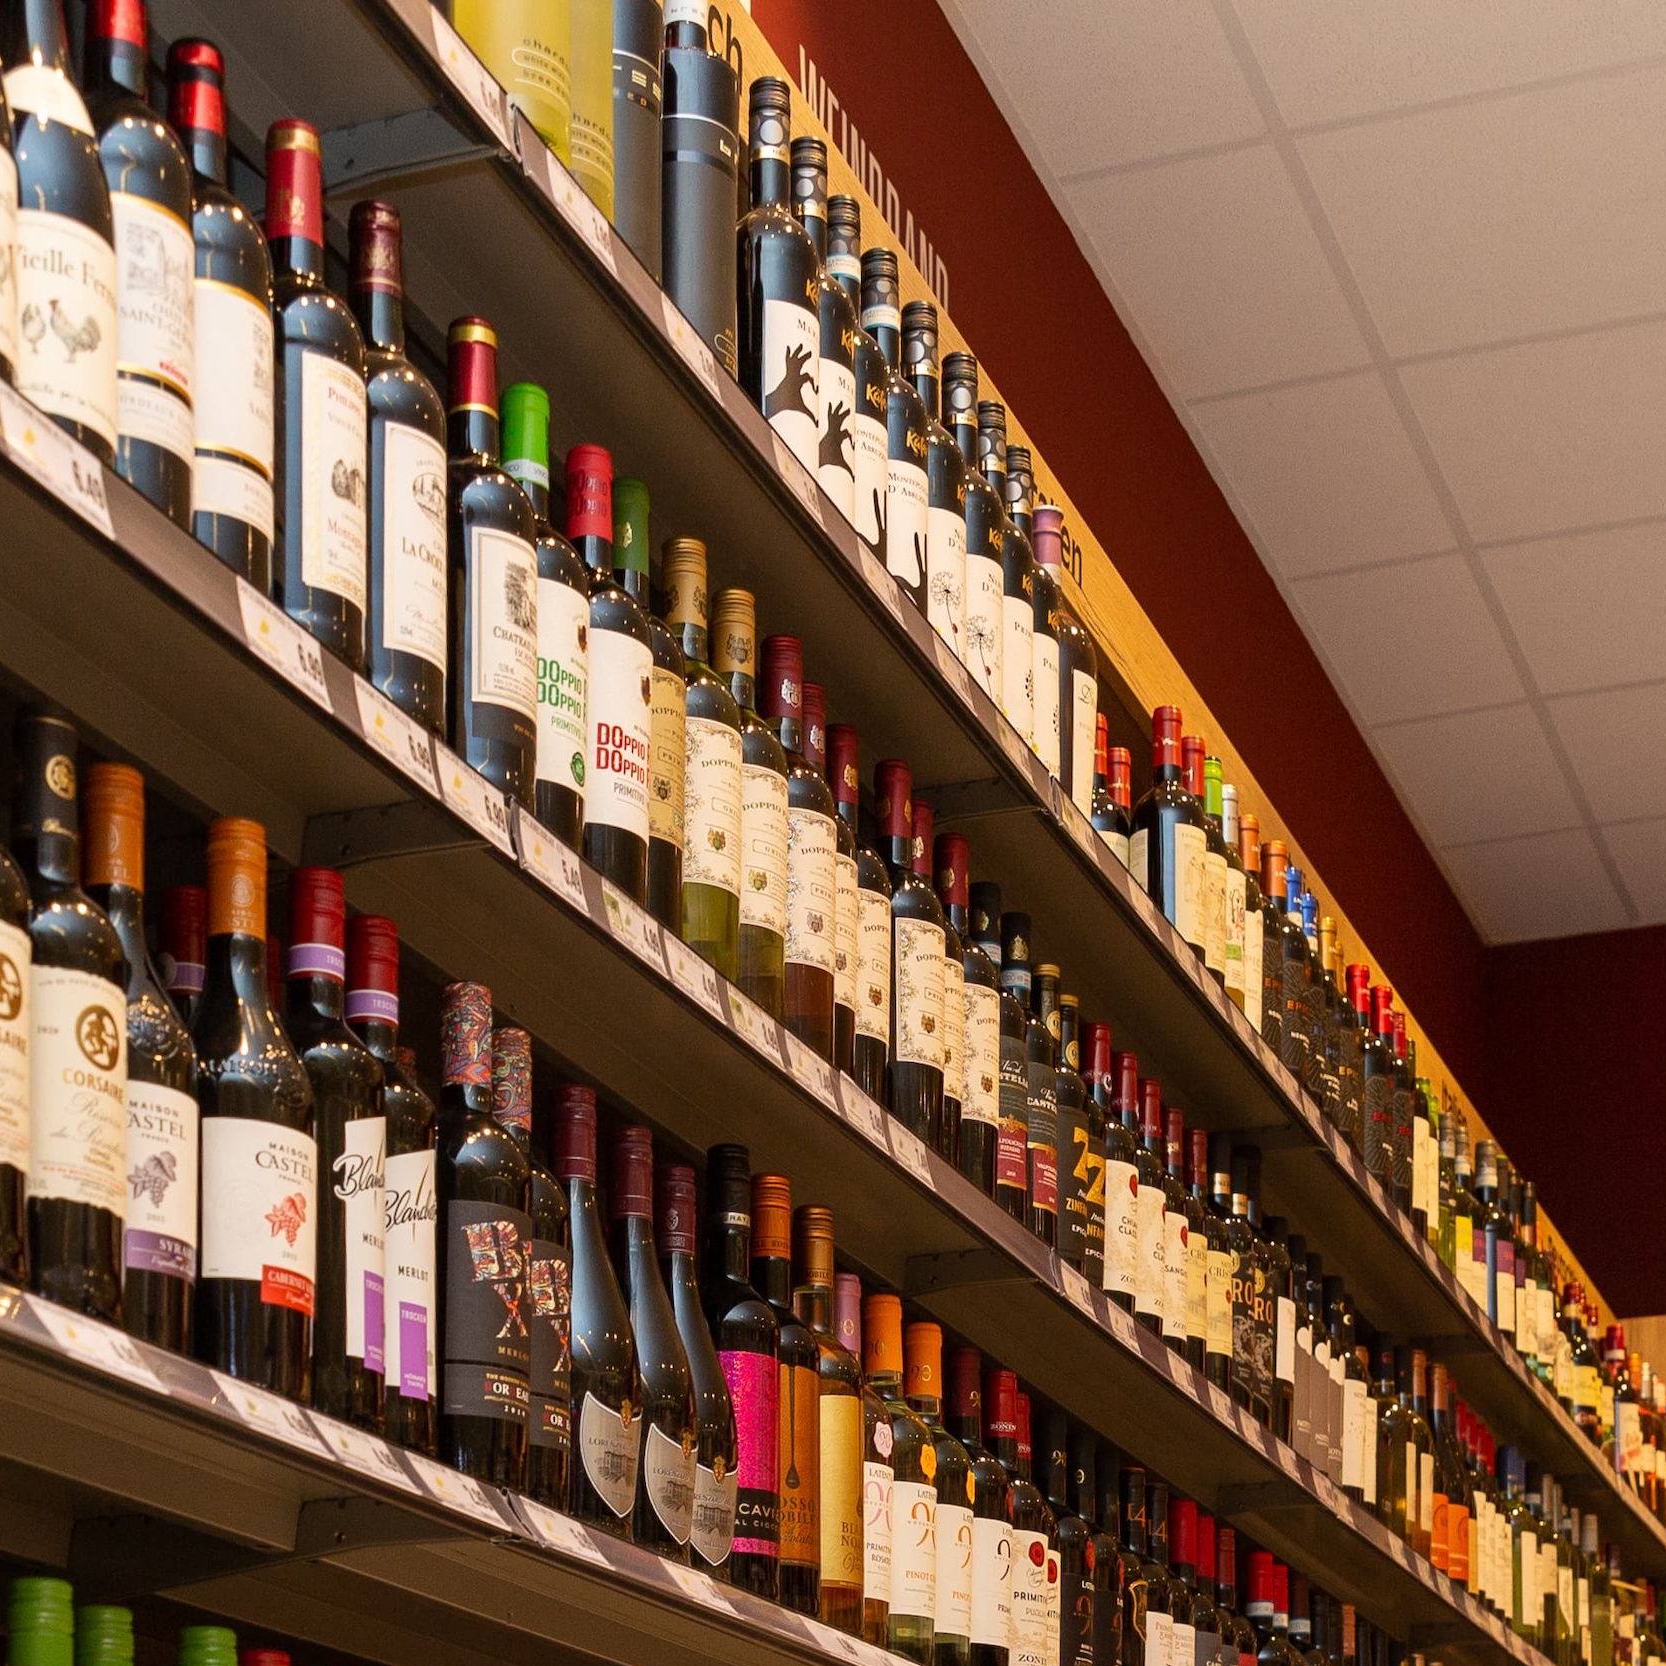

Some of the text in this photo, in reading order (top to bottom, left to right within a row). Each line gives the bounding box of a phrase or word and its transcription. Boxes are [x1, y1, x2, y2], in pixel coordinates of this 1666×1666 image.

[596, 722, 646, 761] DOPPIO
[595, 746, 646, 785] DOPPIO
[62, 1067, 125, 1103] CORSAIRE
[130, 1100, 180, 1117] MAISON
[255, 1149, 315, 1184] CASTEL
[268, 1141, 310, 1162] MAISON
[398, 1264, 429, 1282] MERLOT
